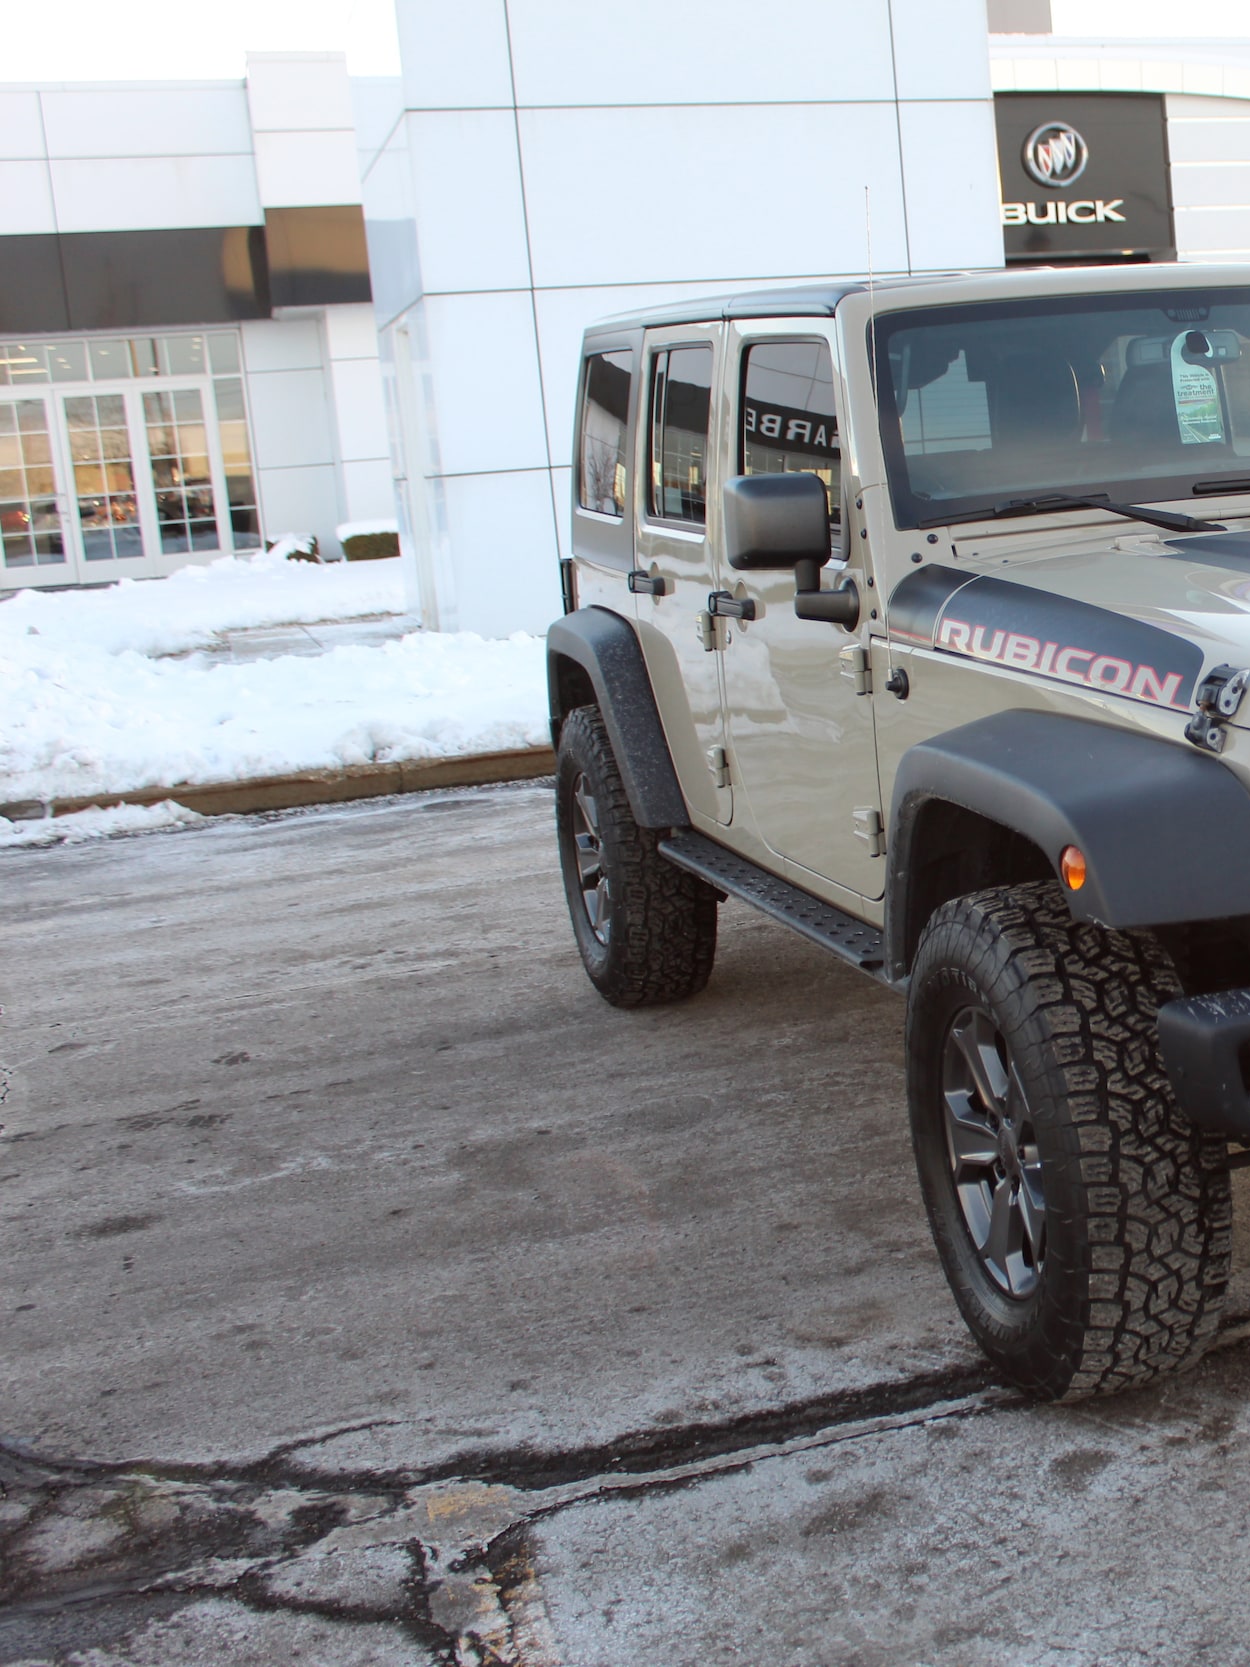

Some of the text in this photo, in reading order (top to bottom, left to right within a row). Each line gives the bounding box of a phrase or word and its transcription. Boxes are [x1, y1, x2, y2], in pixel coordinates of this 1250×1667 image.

[1002, 200, 1126, 226] BUICK
[1178, 389, 1214, 397] treatment
[940, 617, 1183, 701] RUBICON
